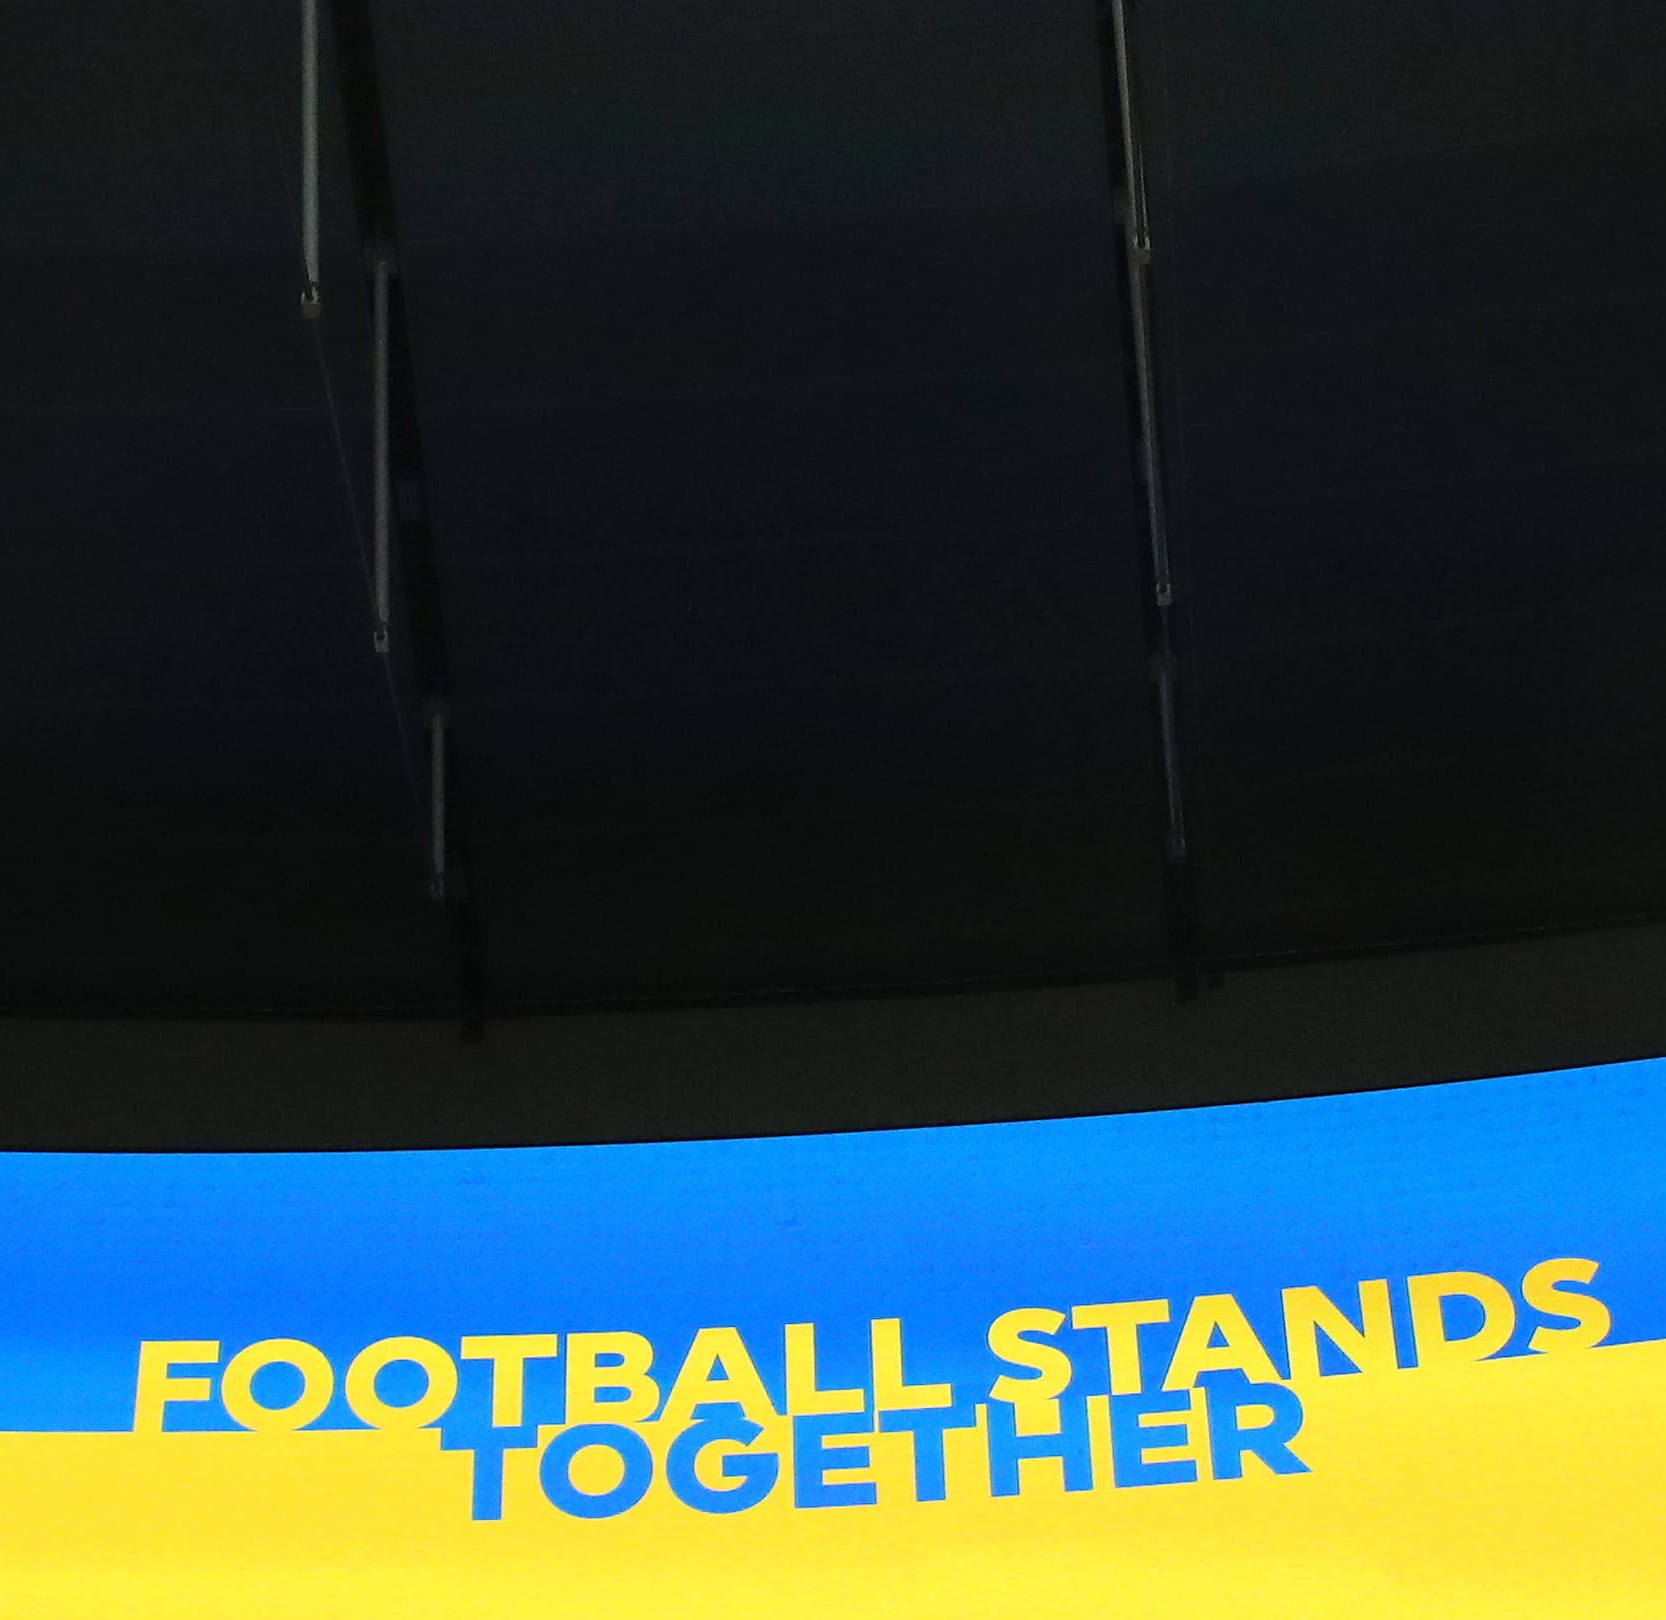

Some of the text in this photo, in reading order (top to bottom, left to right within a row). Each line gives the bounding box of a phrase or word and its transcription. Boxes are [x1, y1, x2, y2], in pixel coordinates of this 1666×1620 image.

[133, 1257, 1611, 1433] FOOTBALL STANDS
[441, 1380, 1310, 1521] TOGETHER
